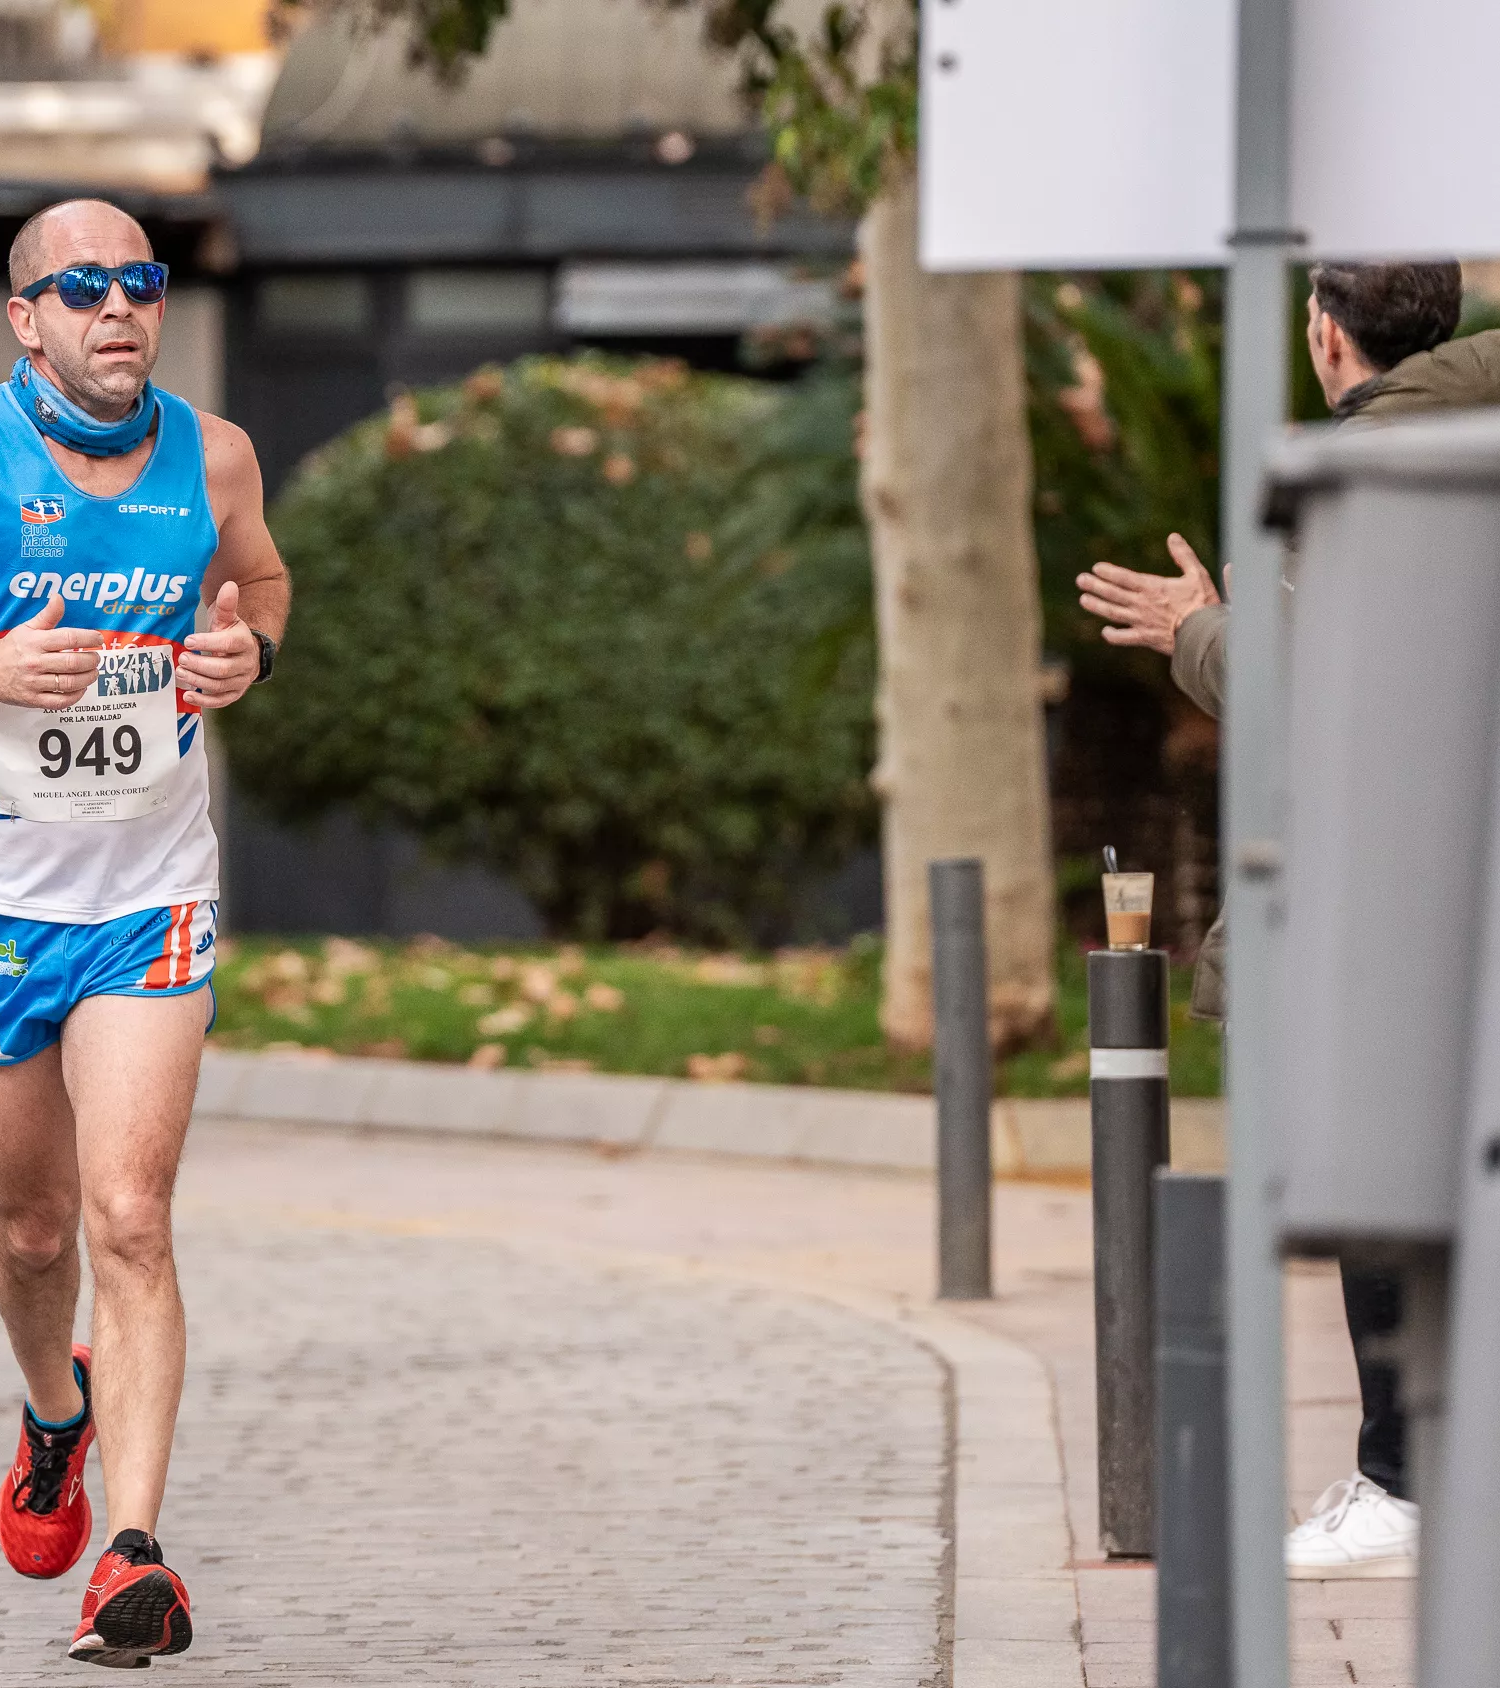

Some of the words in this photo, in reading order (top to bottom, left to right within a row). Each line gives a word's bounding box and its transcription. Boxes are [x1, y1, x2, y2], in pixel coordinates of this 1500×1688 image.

[118, 504, 177, 516] GSPORT
[22, 524, 49, 536] Club
[22, 534, 67, 547] Maratón
[21, 546, 64, 557] Lucena
[103, 600, 176, 616] directo
[98, 651, 142, 676] 2024
[74, 705, 101, 713] CIUDAD
[112, 701, 137, 710] LUCENA
[86, 713, 122, 722] IGUALDAD
[38, 724, 142, 779] 949
[65, 790, 92, 798] ANGEL
[94, 789, 120, 797] ARCOS
